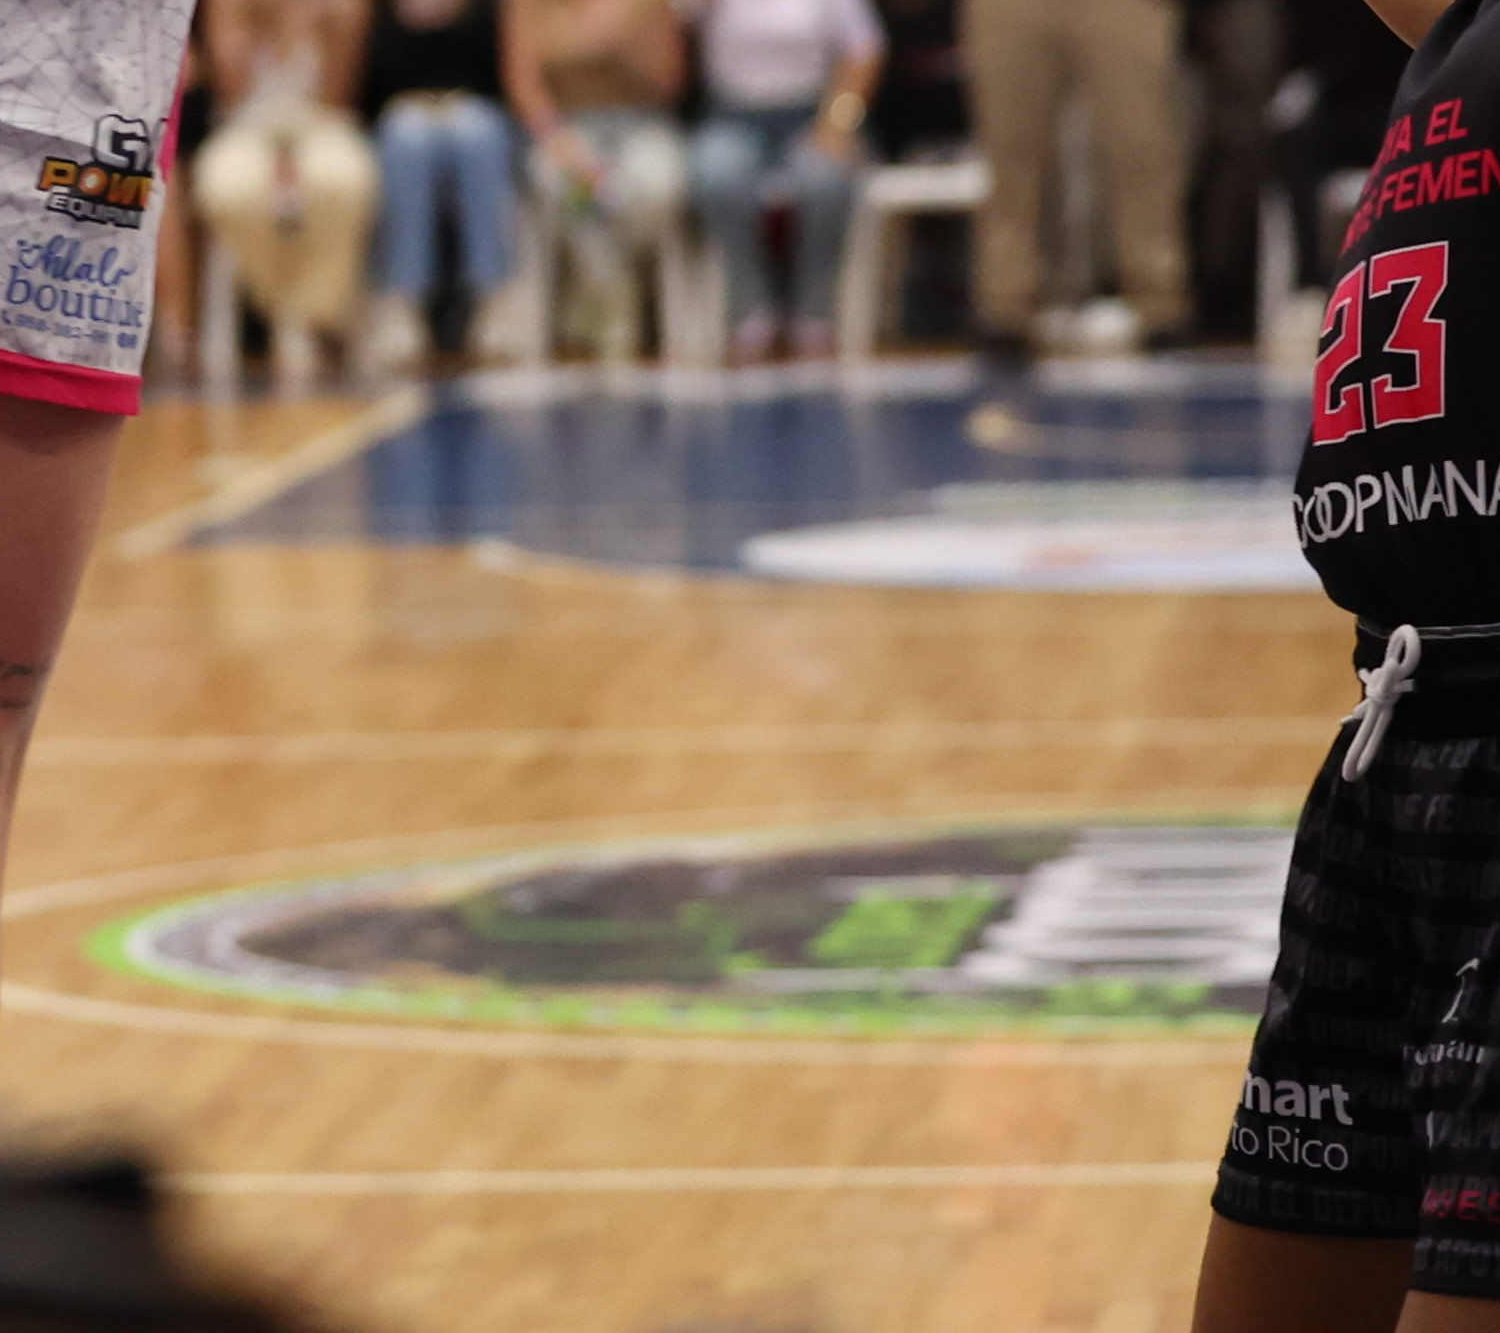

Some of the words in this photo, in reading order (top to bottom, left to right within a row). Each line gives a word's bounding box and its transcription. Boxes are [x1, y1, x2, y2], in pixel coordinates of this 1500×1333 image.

[1425, 97, 1470, 147] EL
[1312, 240, 1449, 446] 23
[1266, 1124, 1350, 1173] Rico
